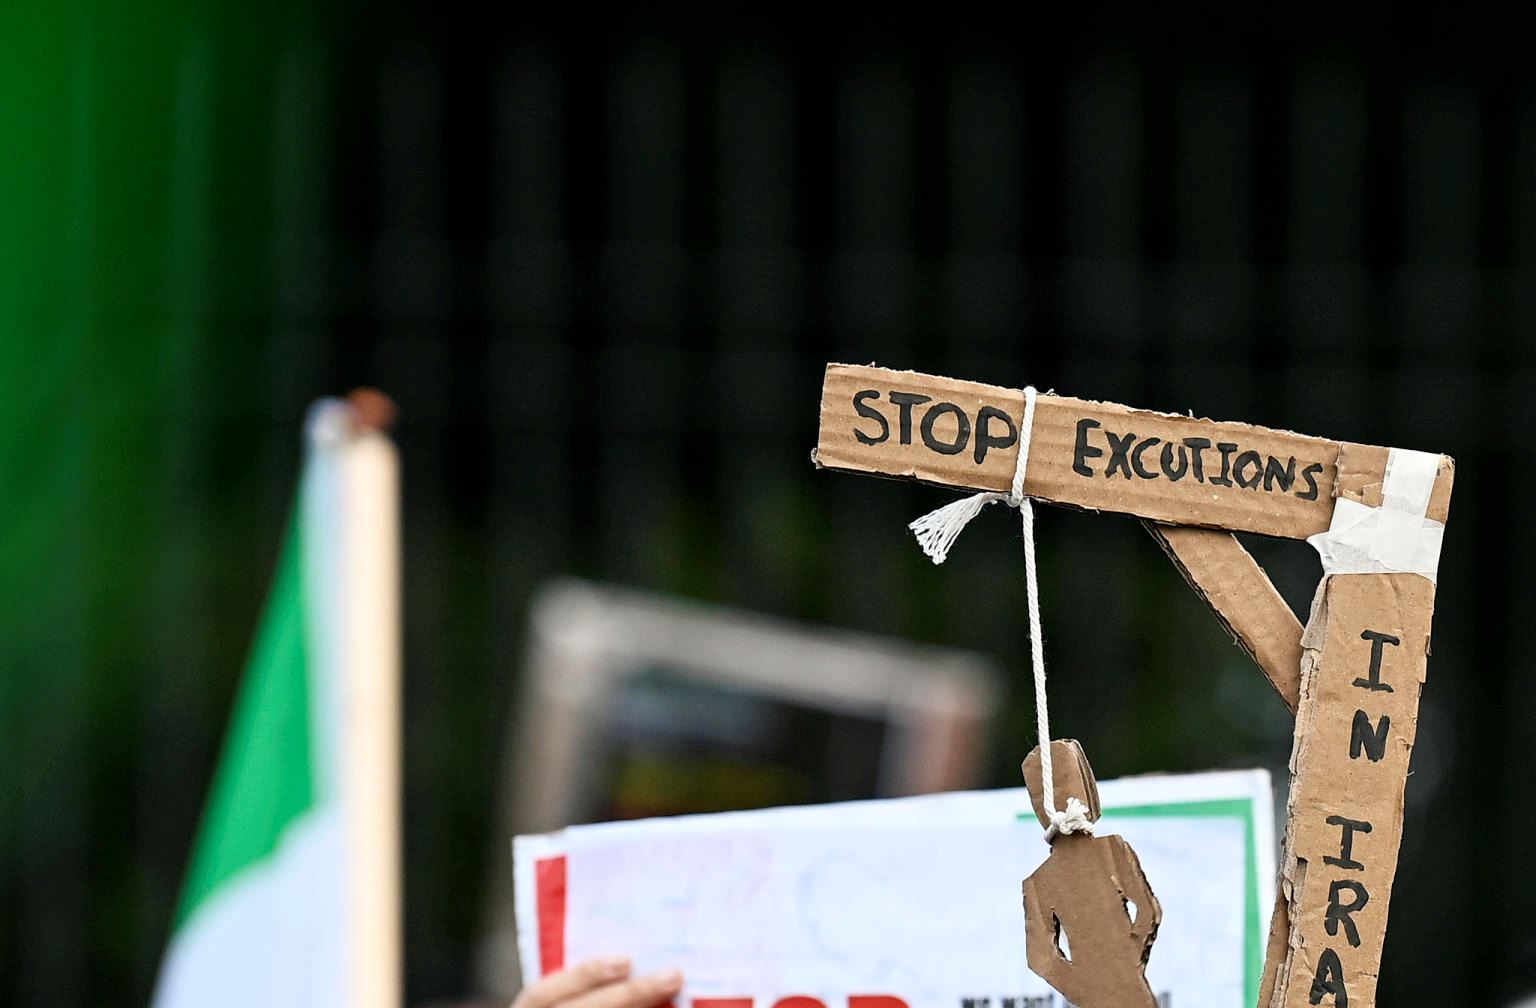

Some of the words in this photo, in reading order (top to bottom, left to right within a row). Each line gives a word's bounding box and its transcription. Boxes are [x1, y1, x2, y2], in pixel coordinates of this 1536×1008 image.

[853, 390, 1018, 464] STOP
[1072, 418, 1324, 500] EXCUTIONS
[1350, 629, 1401, 762] IN
